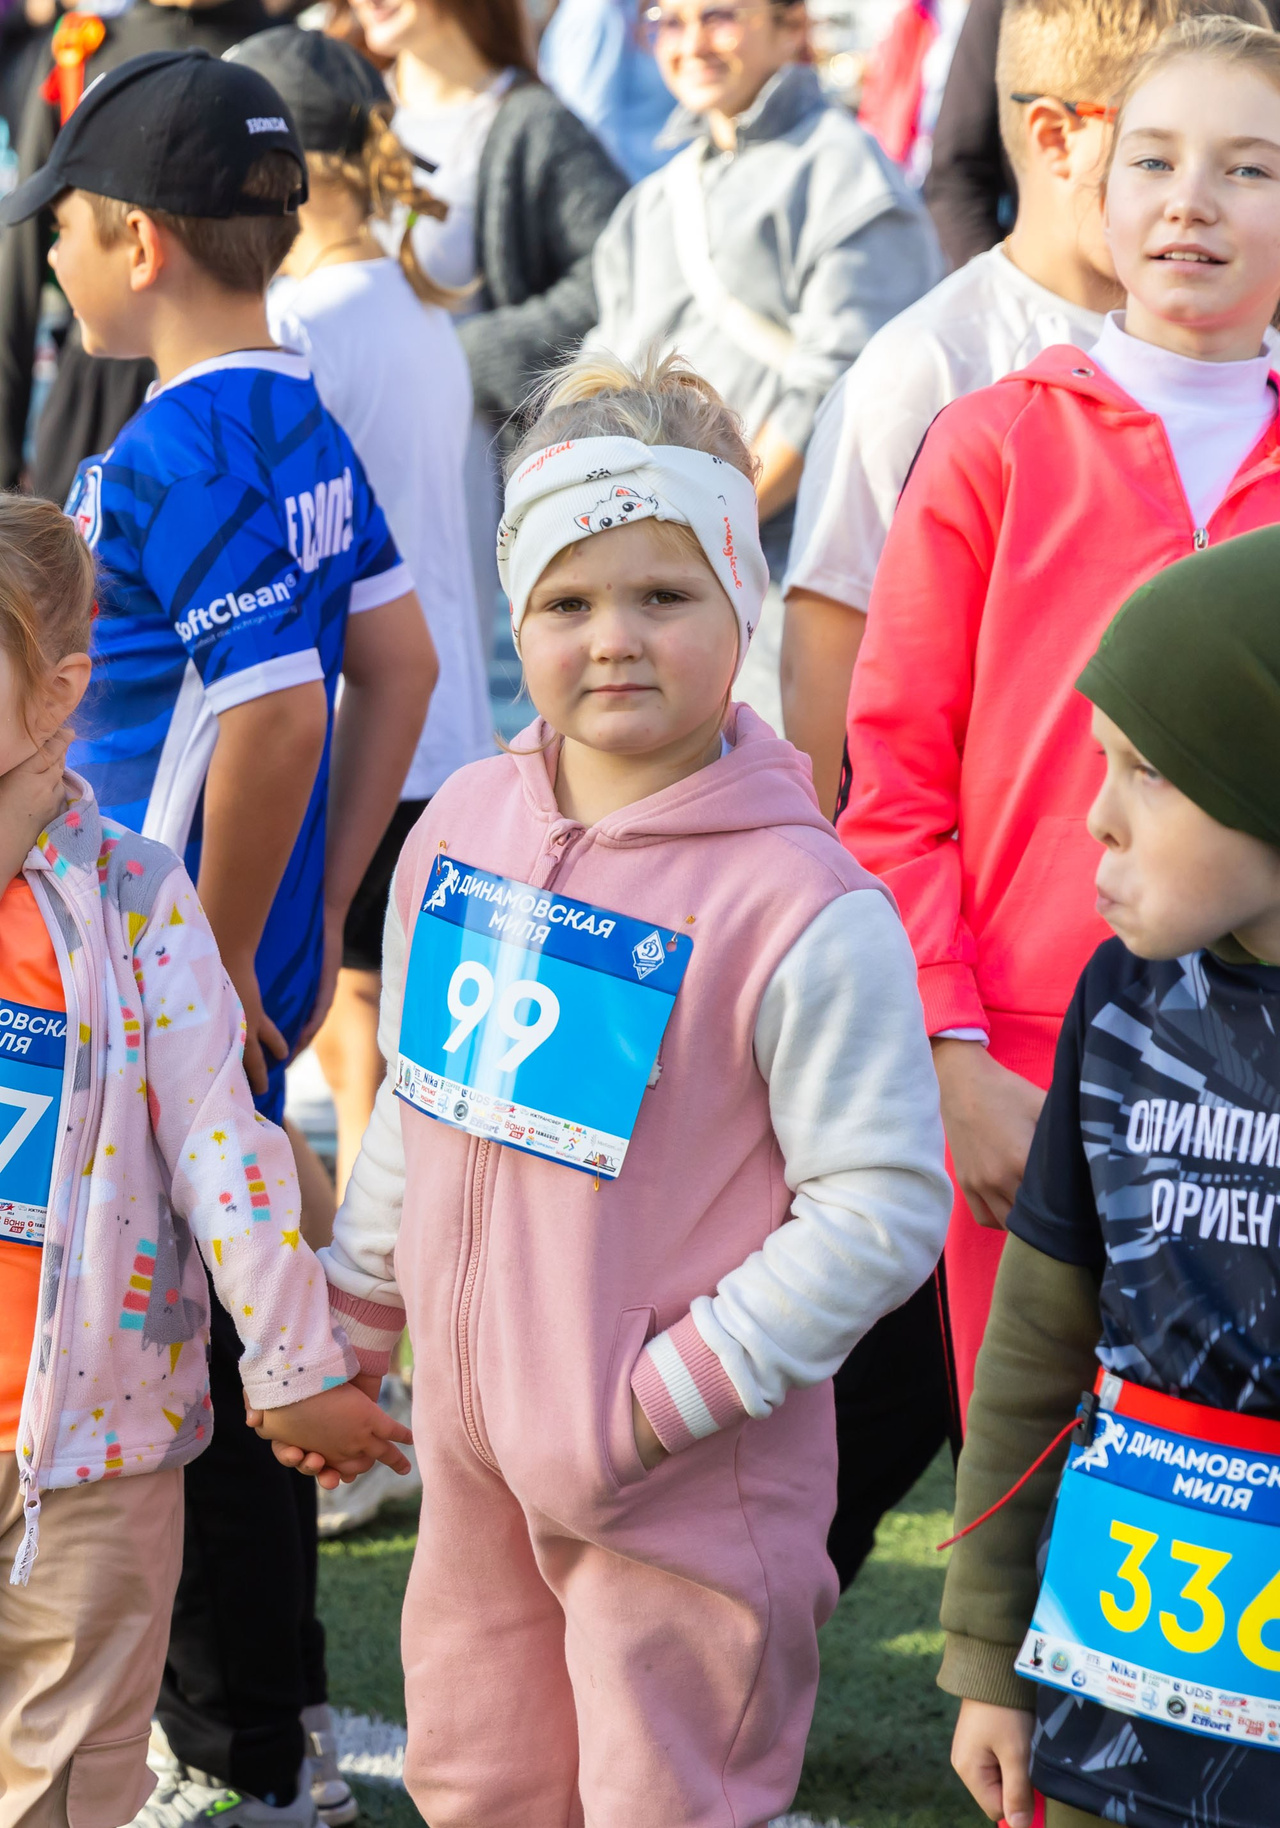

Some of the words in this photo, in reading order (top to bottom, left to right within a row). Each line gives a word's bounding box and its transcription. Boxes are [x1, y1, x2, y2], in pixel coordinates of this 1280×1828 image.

[518, 440, 574, 483] magical
[723, 517, 742, 590] magical
[457, 874, 616, 939] ДИНАМОВСКАЯ
[489, 910, 551, 945] МИЛЯ
[442, 960, 560, 1073] 99
[468, 1091, 489, 1106] UDS
[1126, 1098, 1280, 1168] ОЛИМПИ
[1172, 1473, 1253, 1511] МИЛЯ
[1100, 1519, 1280, 1672] 336
[1184, 1685, 1213, 1701] UDS
[1191, 1713, 1231, 1732] Effort
